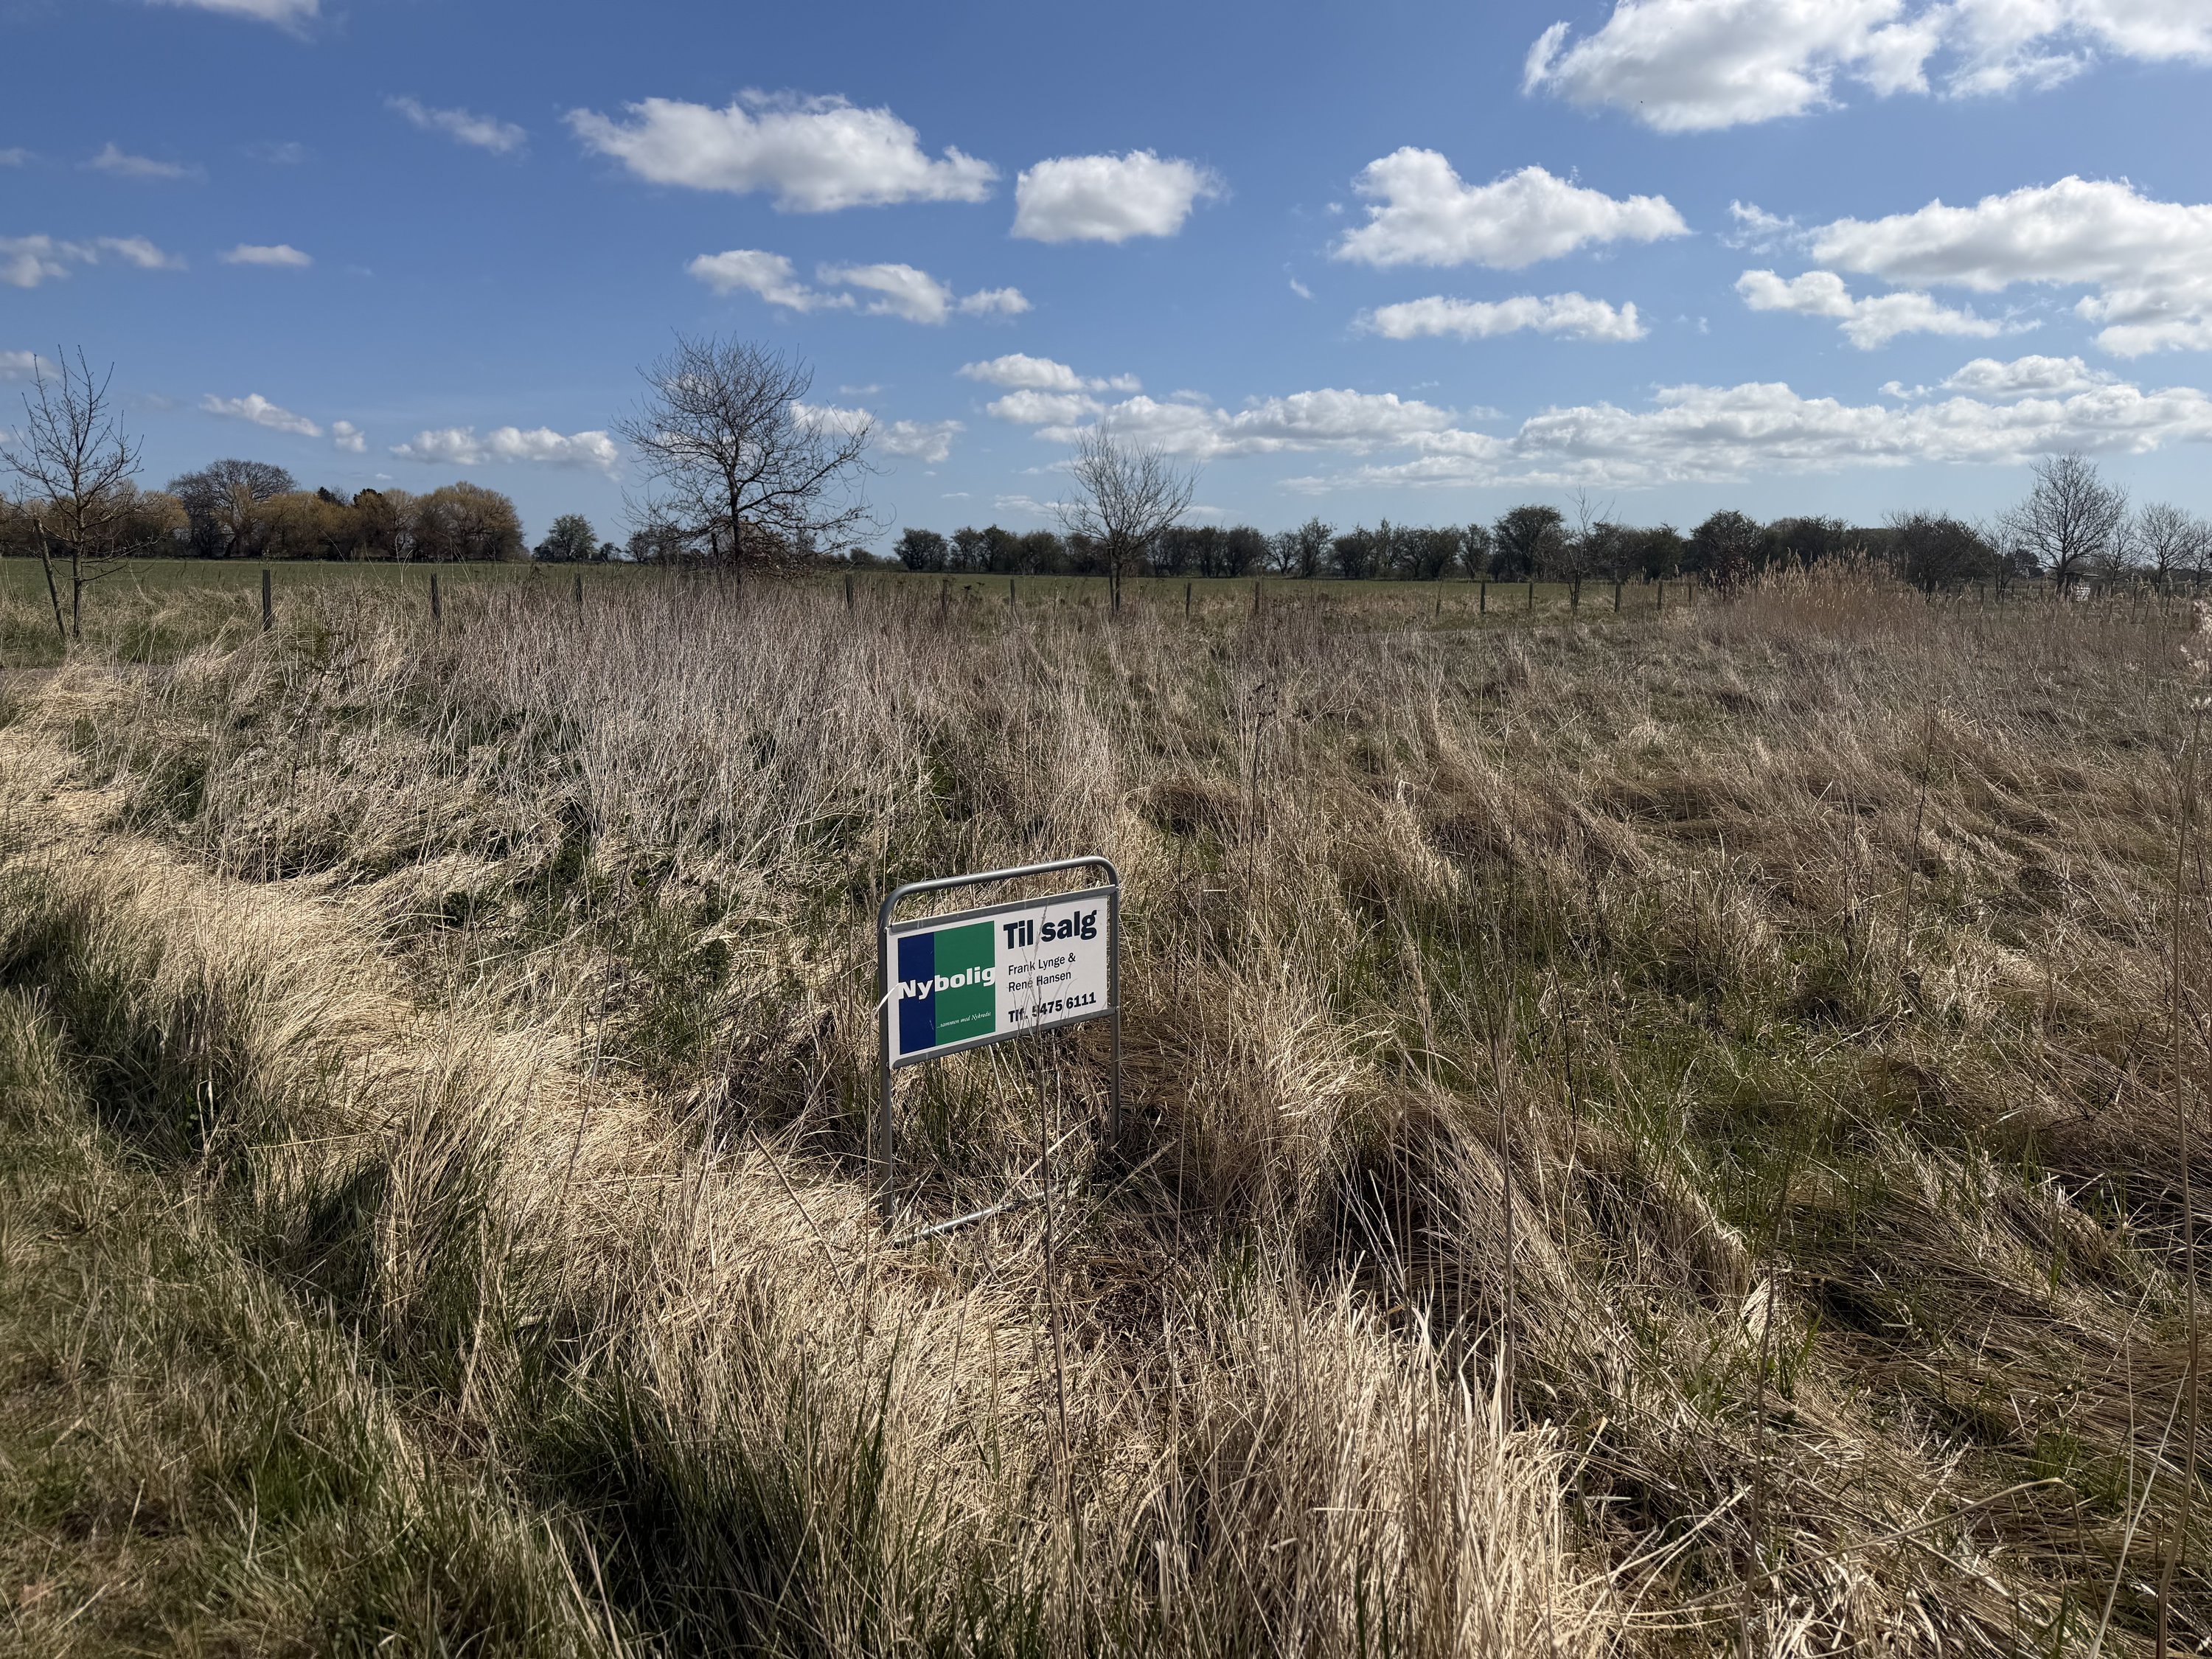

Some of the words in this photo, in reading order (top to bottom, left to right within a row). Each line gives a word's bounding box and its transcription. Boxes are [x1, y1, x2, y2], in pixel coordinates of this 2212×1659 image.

[1004, 919, 1034, 950] Til
[1041, 910, 1097, 942] salg
[1008, 961, 1036, 975] Frank
[1038, 956, 1065, 970] Lynge
[1068, 952, 1077, 963] &
[1036, 971, 1071, 987] Hansen
[899, 966, 995, 1000] Nybolig
[1008, 1007, 1029, 1023] Tlf.
[1032, 999, 1062, 1017] 5475
[1066, 992, 1096, 1009] 6111
